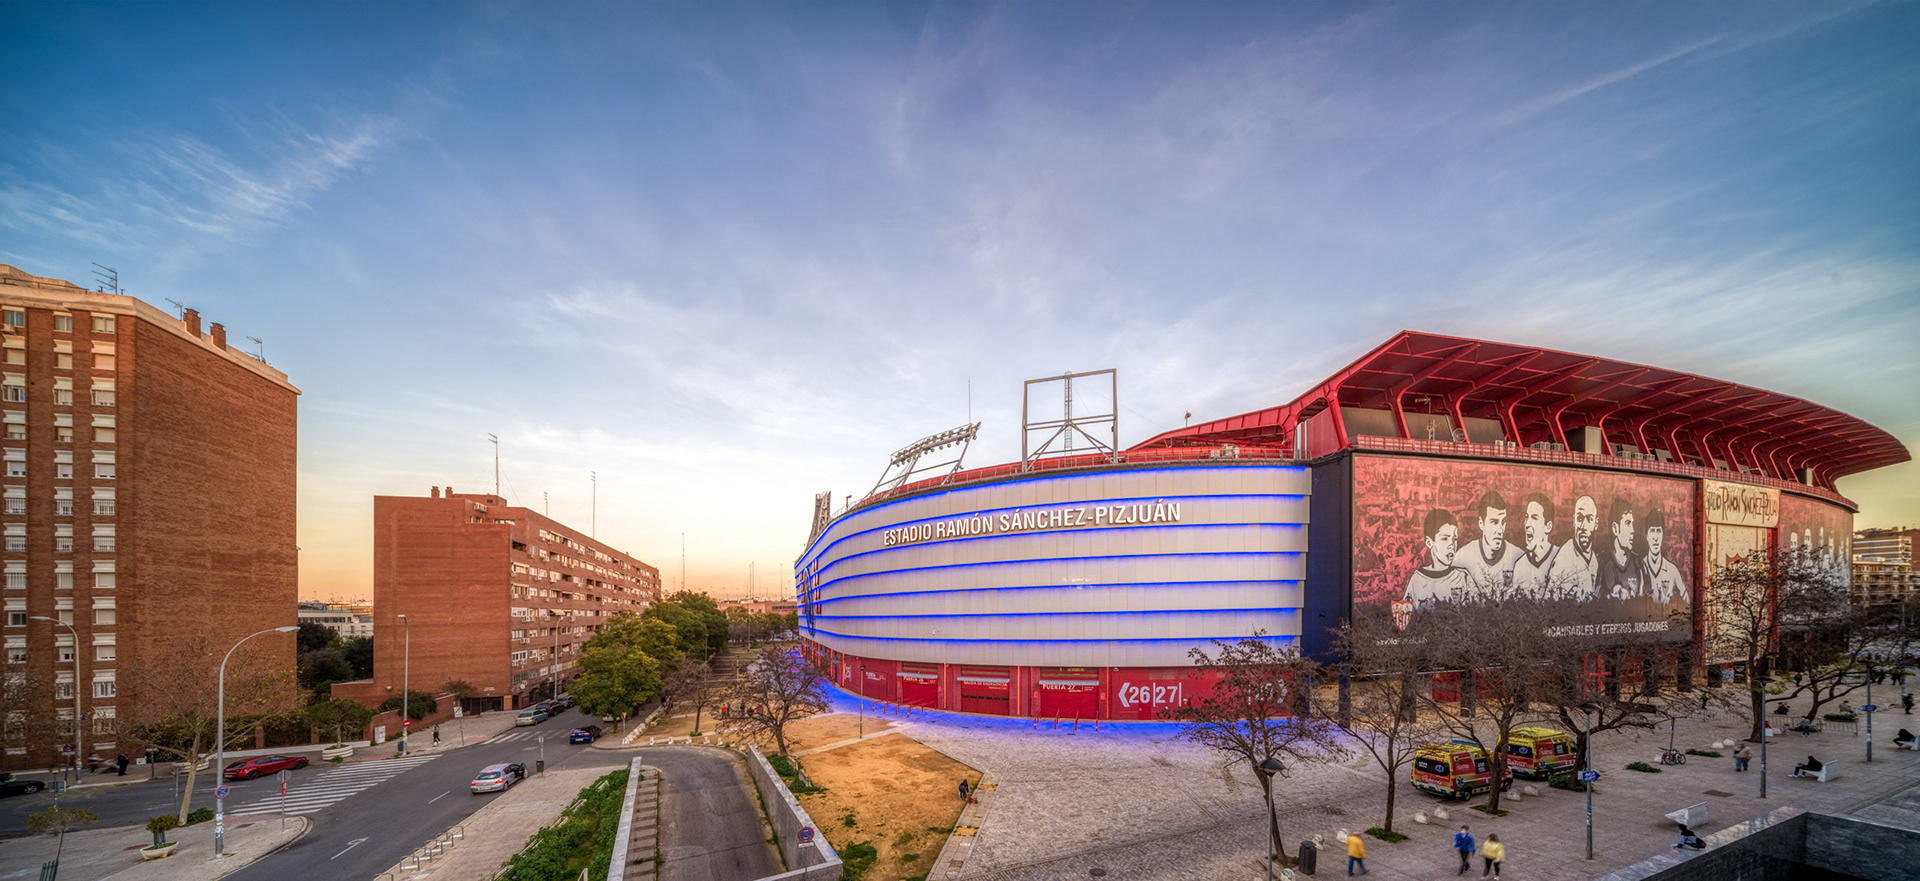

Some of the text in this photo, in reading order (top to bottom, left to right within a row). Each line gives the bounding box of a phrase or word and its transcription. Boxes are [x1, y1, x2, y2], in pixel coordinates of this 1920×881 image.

[884, 499, 1181, 546] ESTADIO RAMÓN SÁNCHEZ-PIZJUÁN
[1595, 624, 1600, 635] Y
[1633, 621, 1669, 633] JUGADORES
